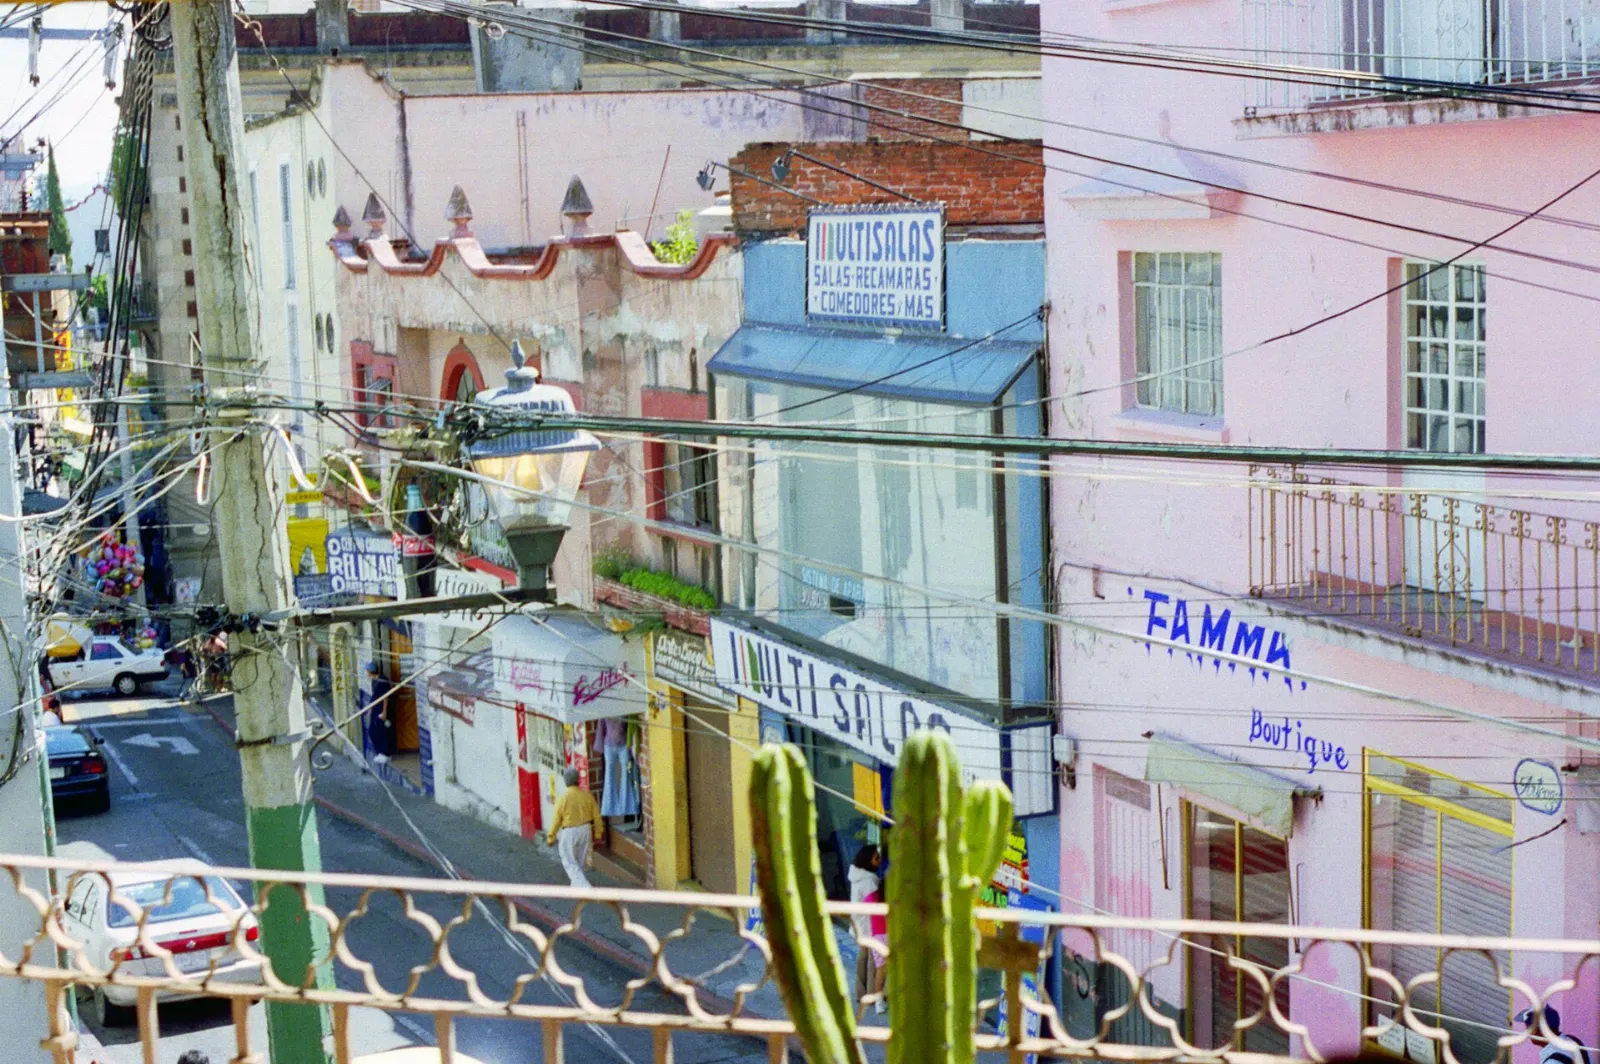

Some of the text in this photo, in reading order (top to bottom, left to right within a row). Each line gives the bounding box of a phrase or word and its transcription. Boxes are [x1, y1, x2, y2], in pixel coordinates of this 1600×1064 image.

[815, 219, 935, 263] MULTISALAS
[820, 290, 896, 316] COMEDORES
[905, 295, 934, 319] MAS
[1249, 707, 1349, 775] Boutique
